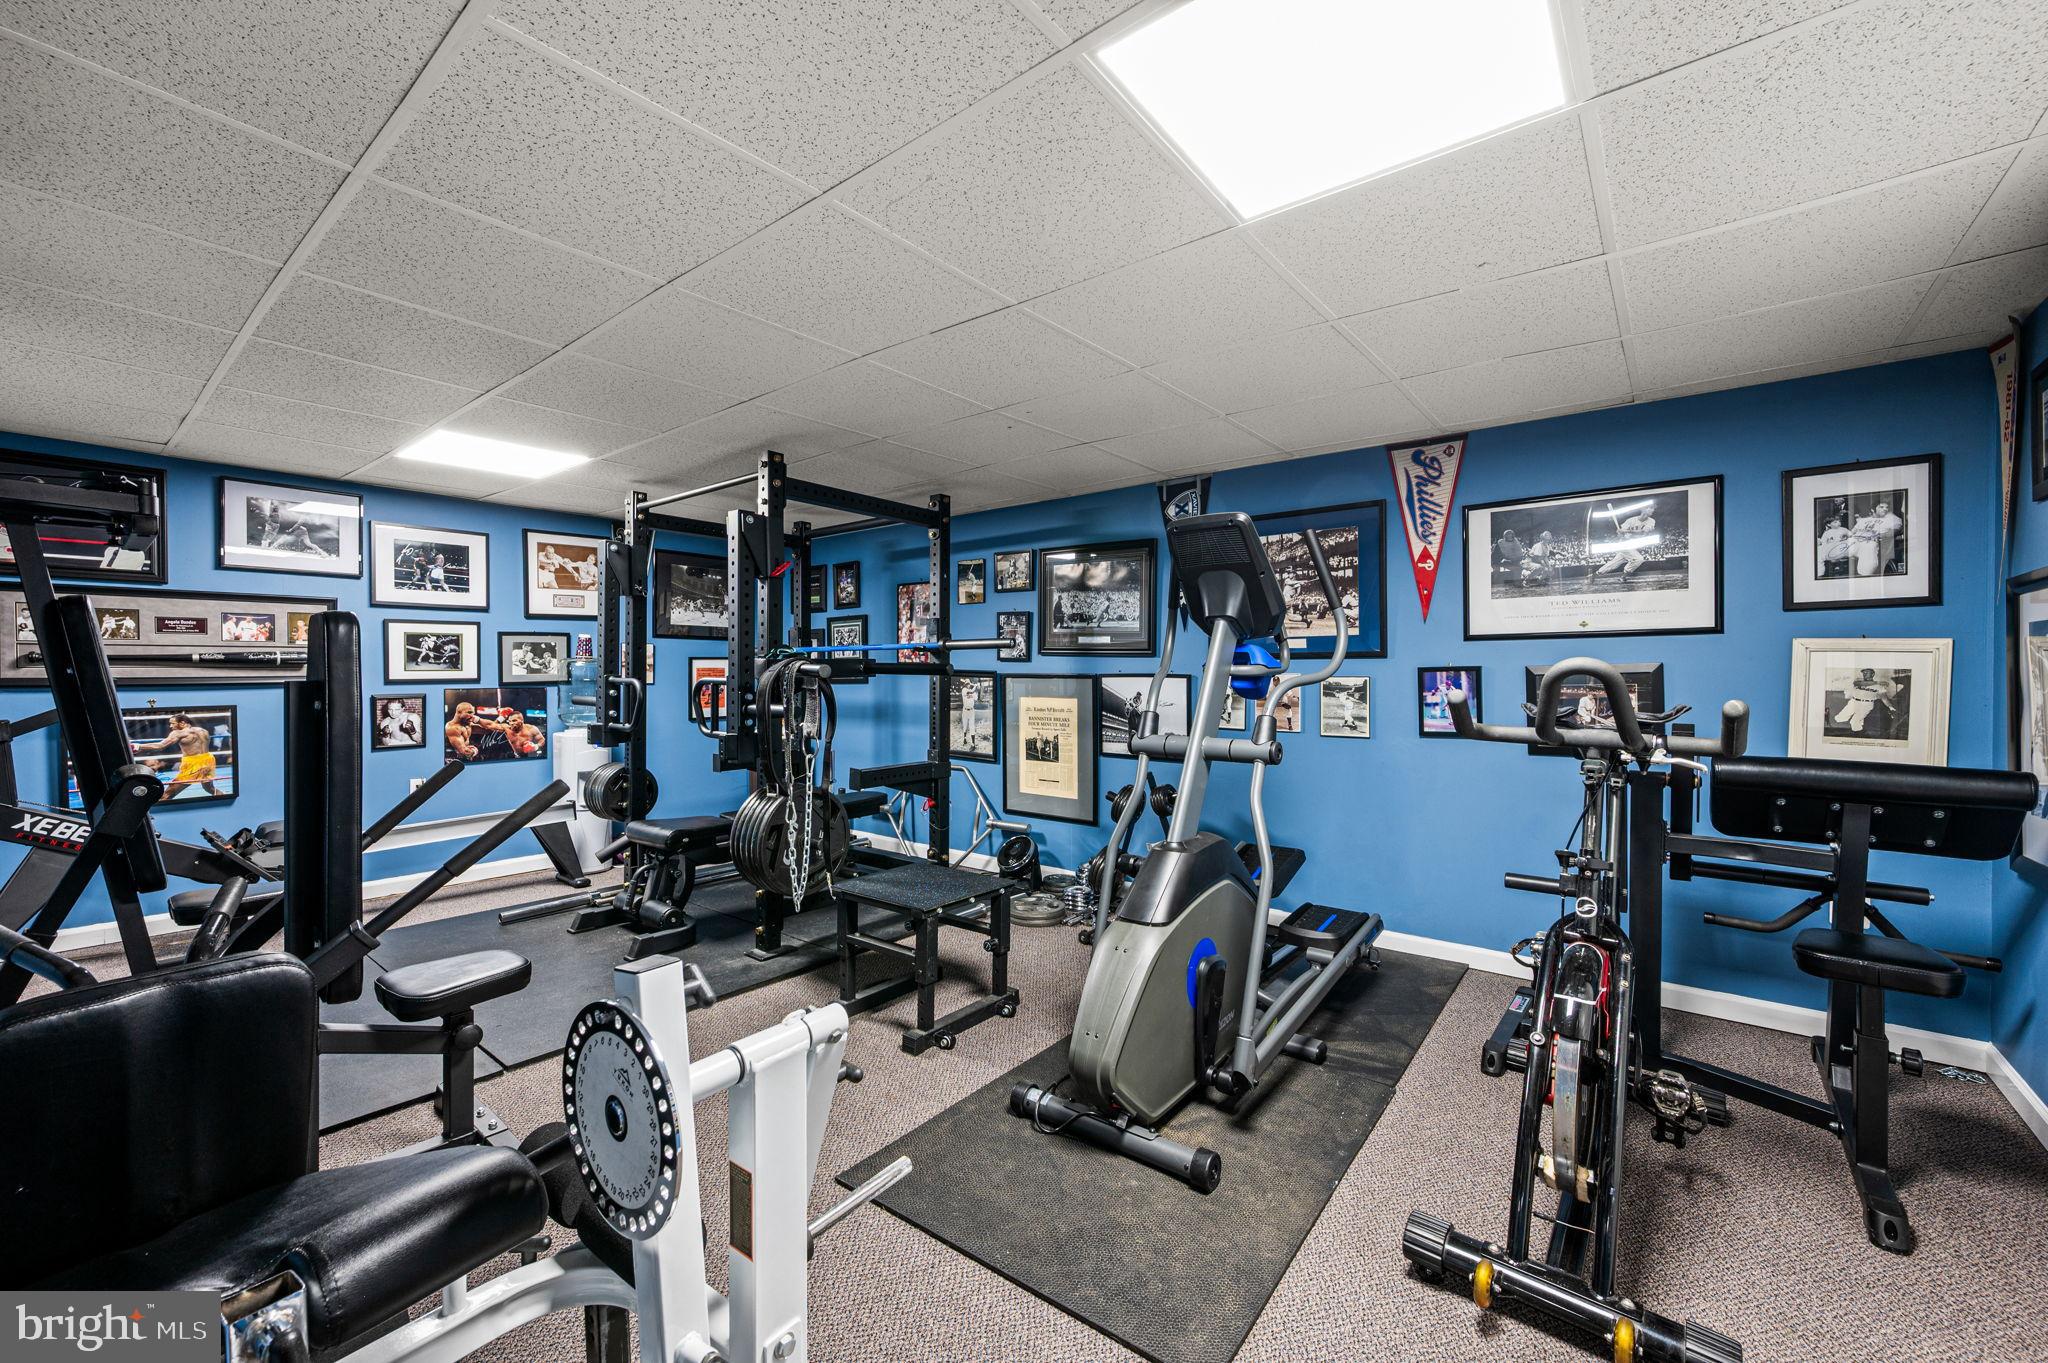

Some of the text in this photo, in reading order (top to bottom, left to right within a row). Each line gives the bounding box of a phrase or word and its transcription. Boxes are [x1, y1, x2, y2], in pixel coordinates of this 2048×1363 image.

[2004, 374, 2013, 443] 1981-82
[1190, 492, 1198, 516] XAVIE
[1411, 449, 1445, 544] Phillies
[11, 813, 91, 842] XEBE
[16, 832, 84, 851] FITNES
